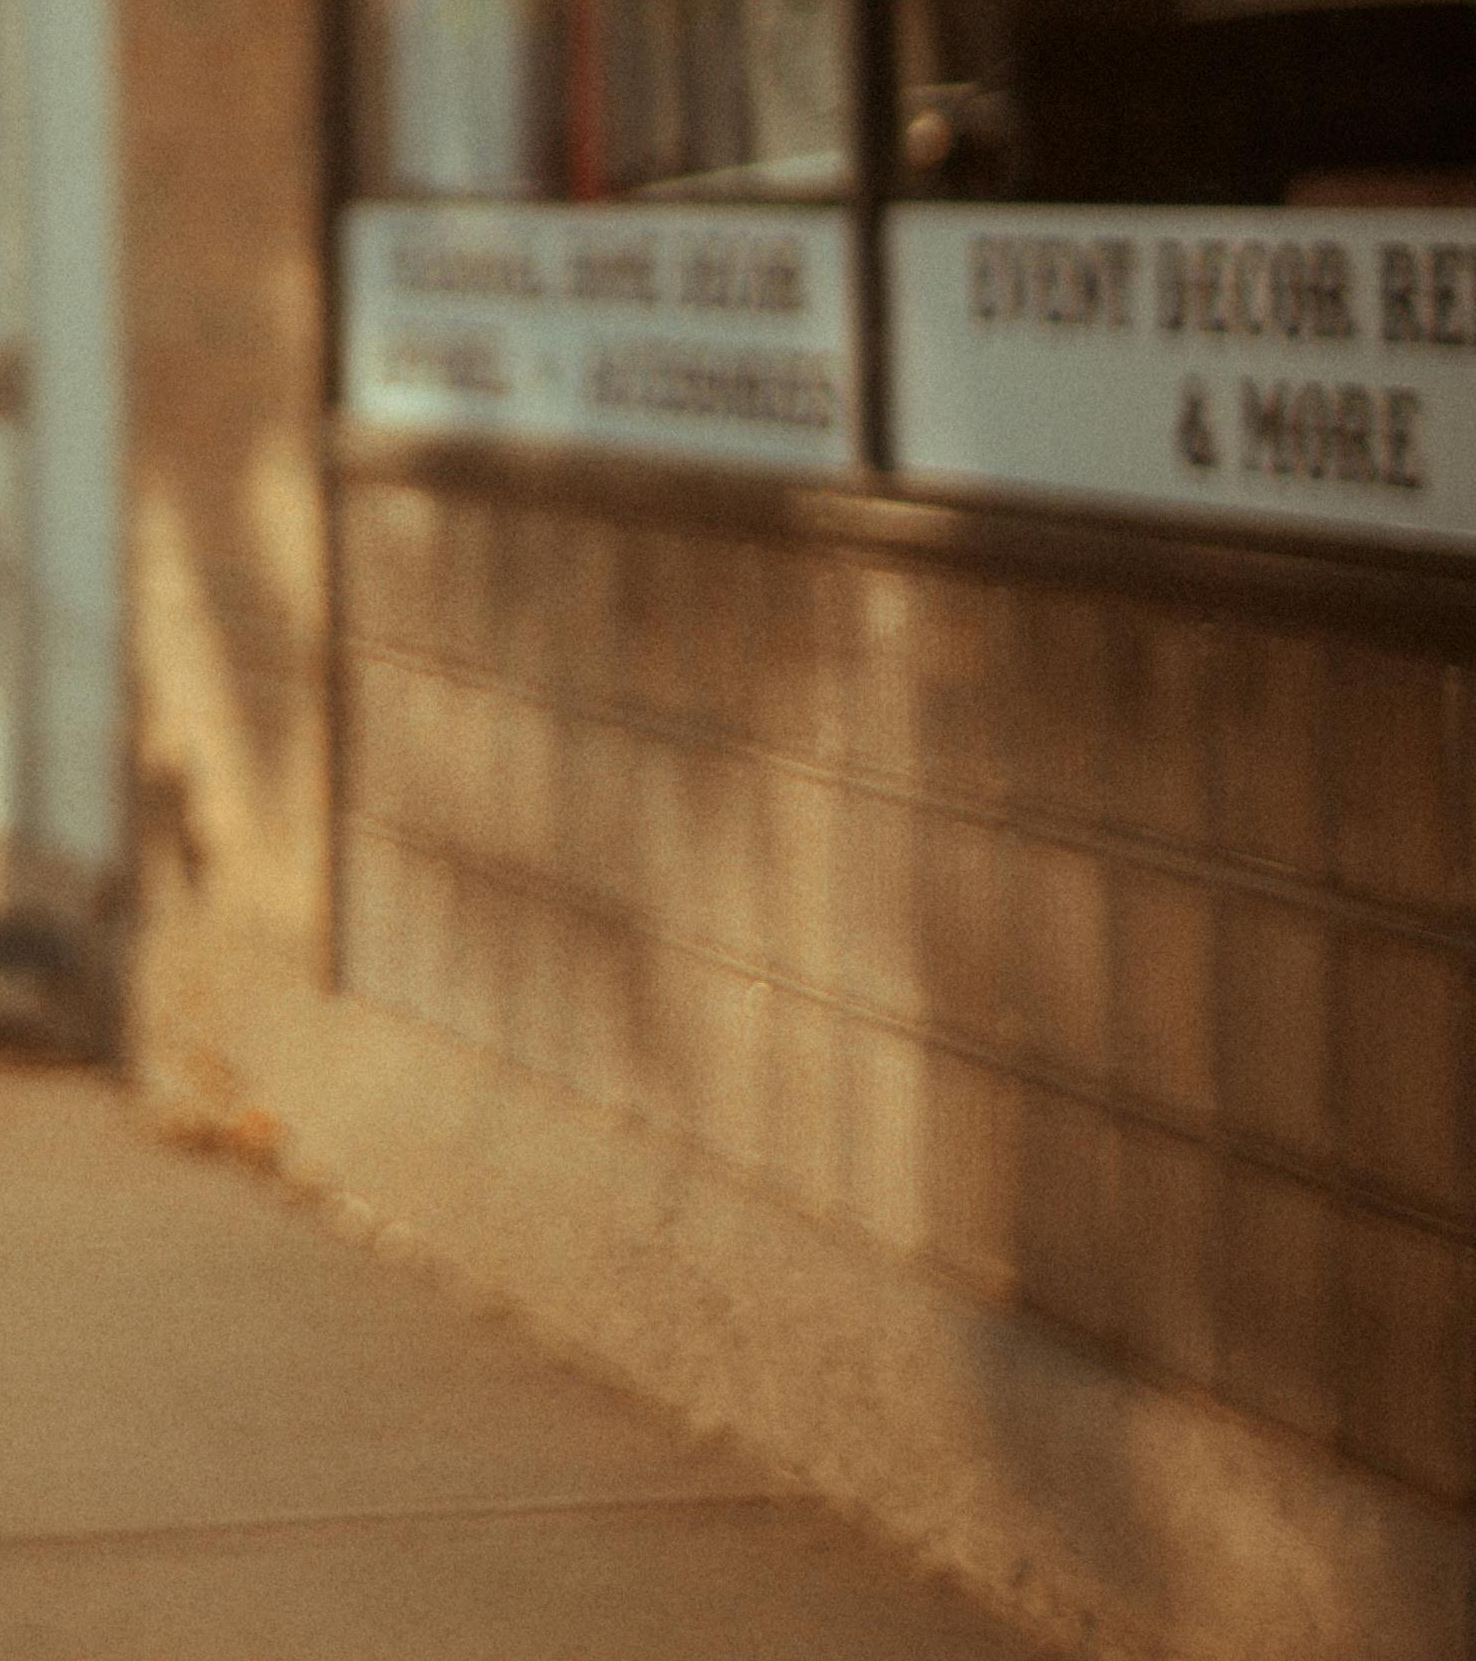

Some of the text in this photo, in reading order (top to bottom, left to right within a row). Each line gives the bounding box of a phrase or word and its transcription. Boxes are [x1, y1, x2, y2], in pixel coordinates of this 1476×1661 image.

[970, 233, 1476, 347] EVENT DECOR RE
[1176, 375, 1424, 492] & MORE
